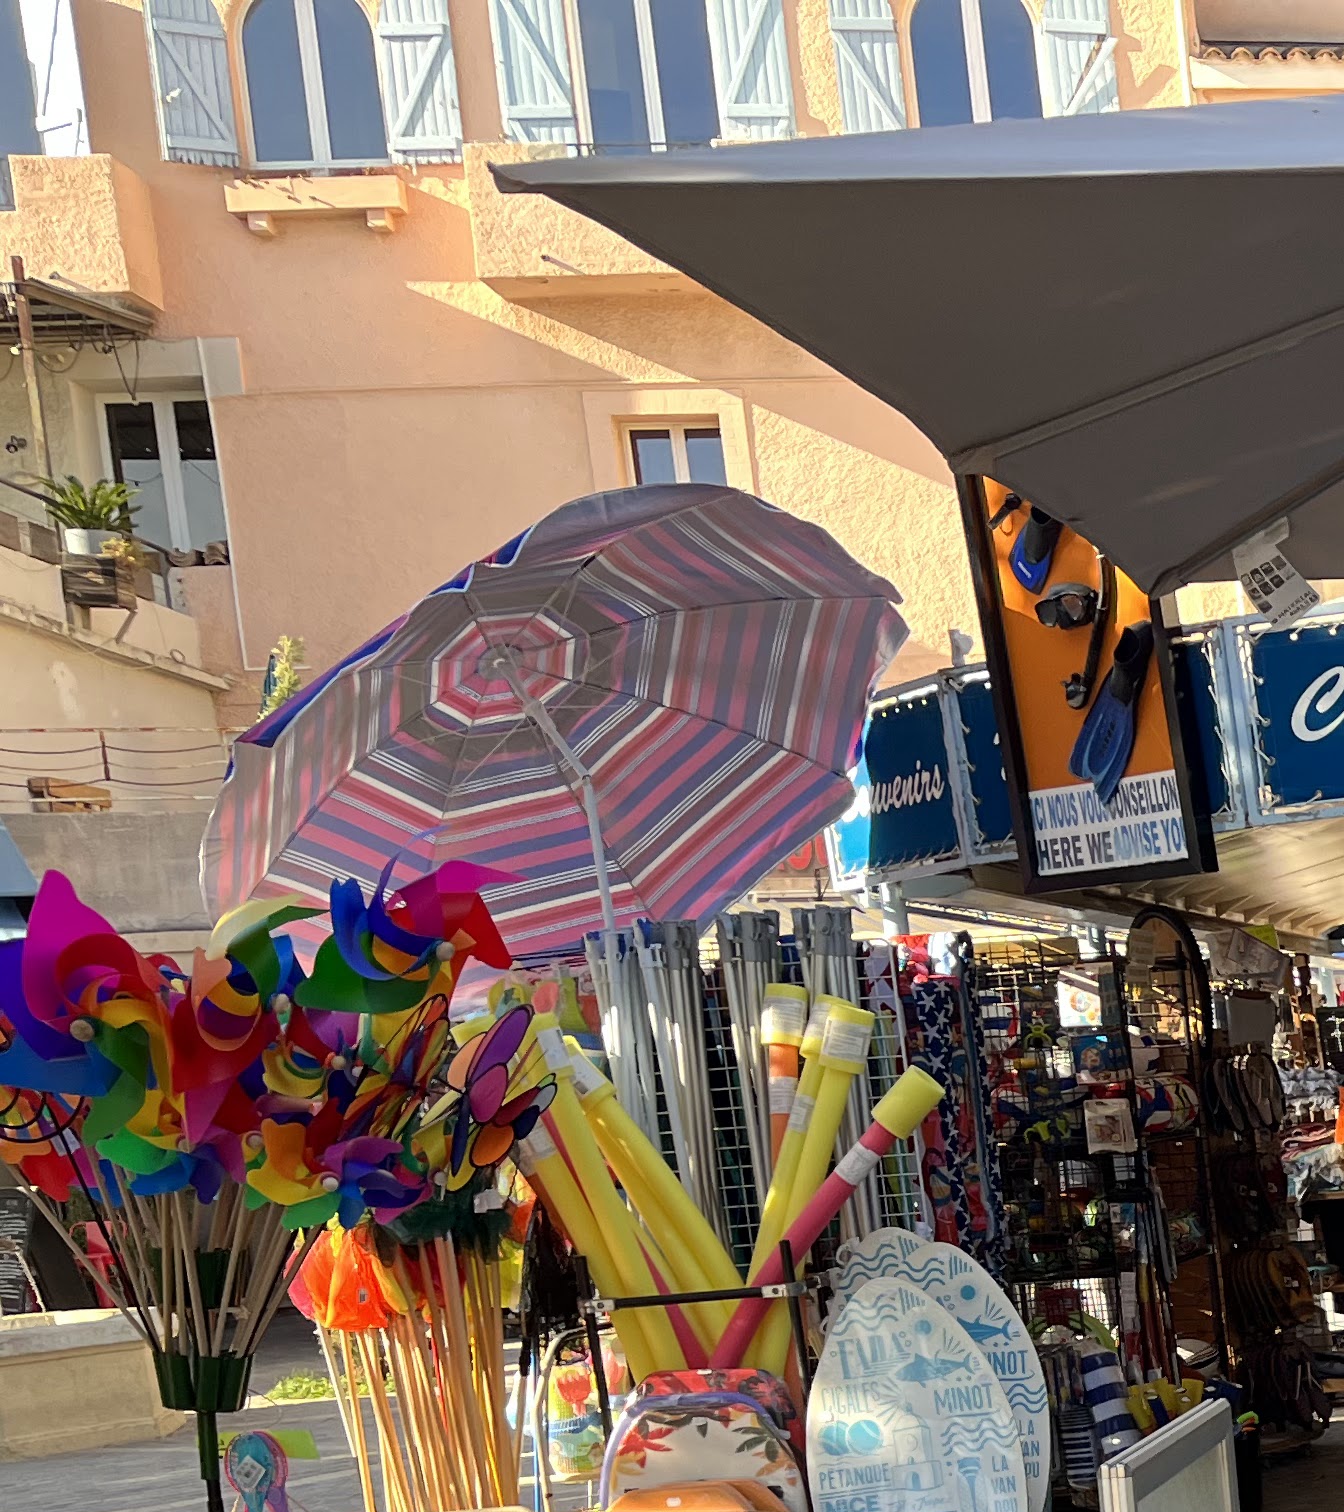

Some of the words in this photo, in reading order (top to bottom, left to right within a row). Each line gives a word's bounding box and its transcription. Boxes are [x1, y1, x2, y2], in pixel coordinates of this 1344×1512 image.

[1046, 791, 1080, 829] NOUS
[1037, 835, 1085, 871] HERE
[1086, 830, 1115, 864] WE
[1113, 820, 1161, 860] ADVISE
[933, 1383, 993, 1415] MINOT
[991, 1455, 1009, 1472] LA
[990, 1476, 1017, 1493] VAN
